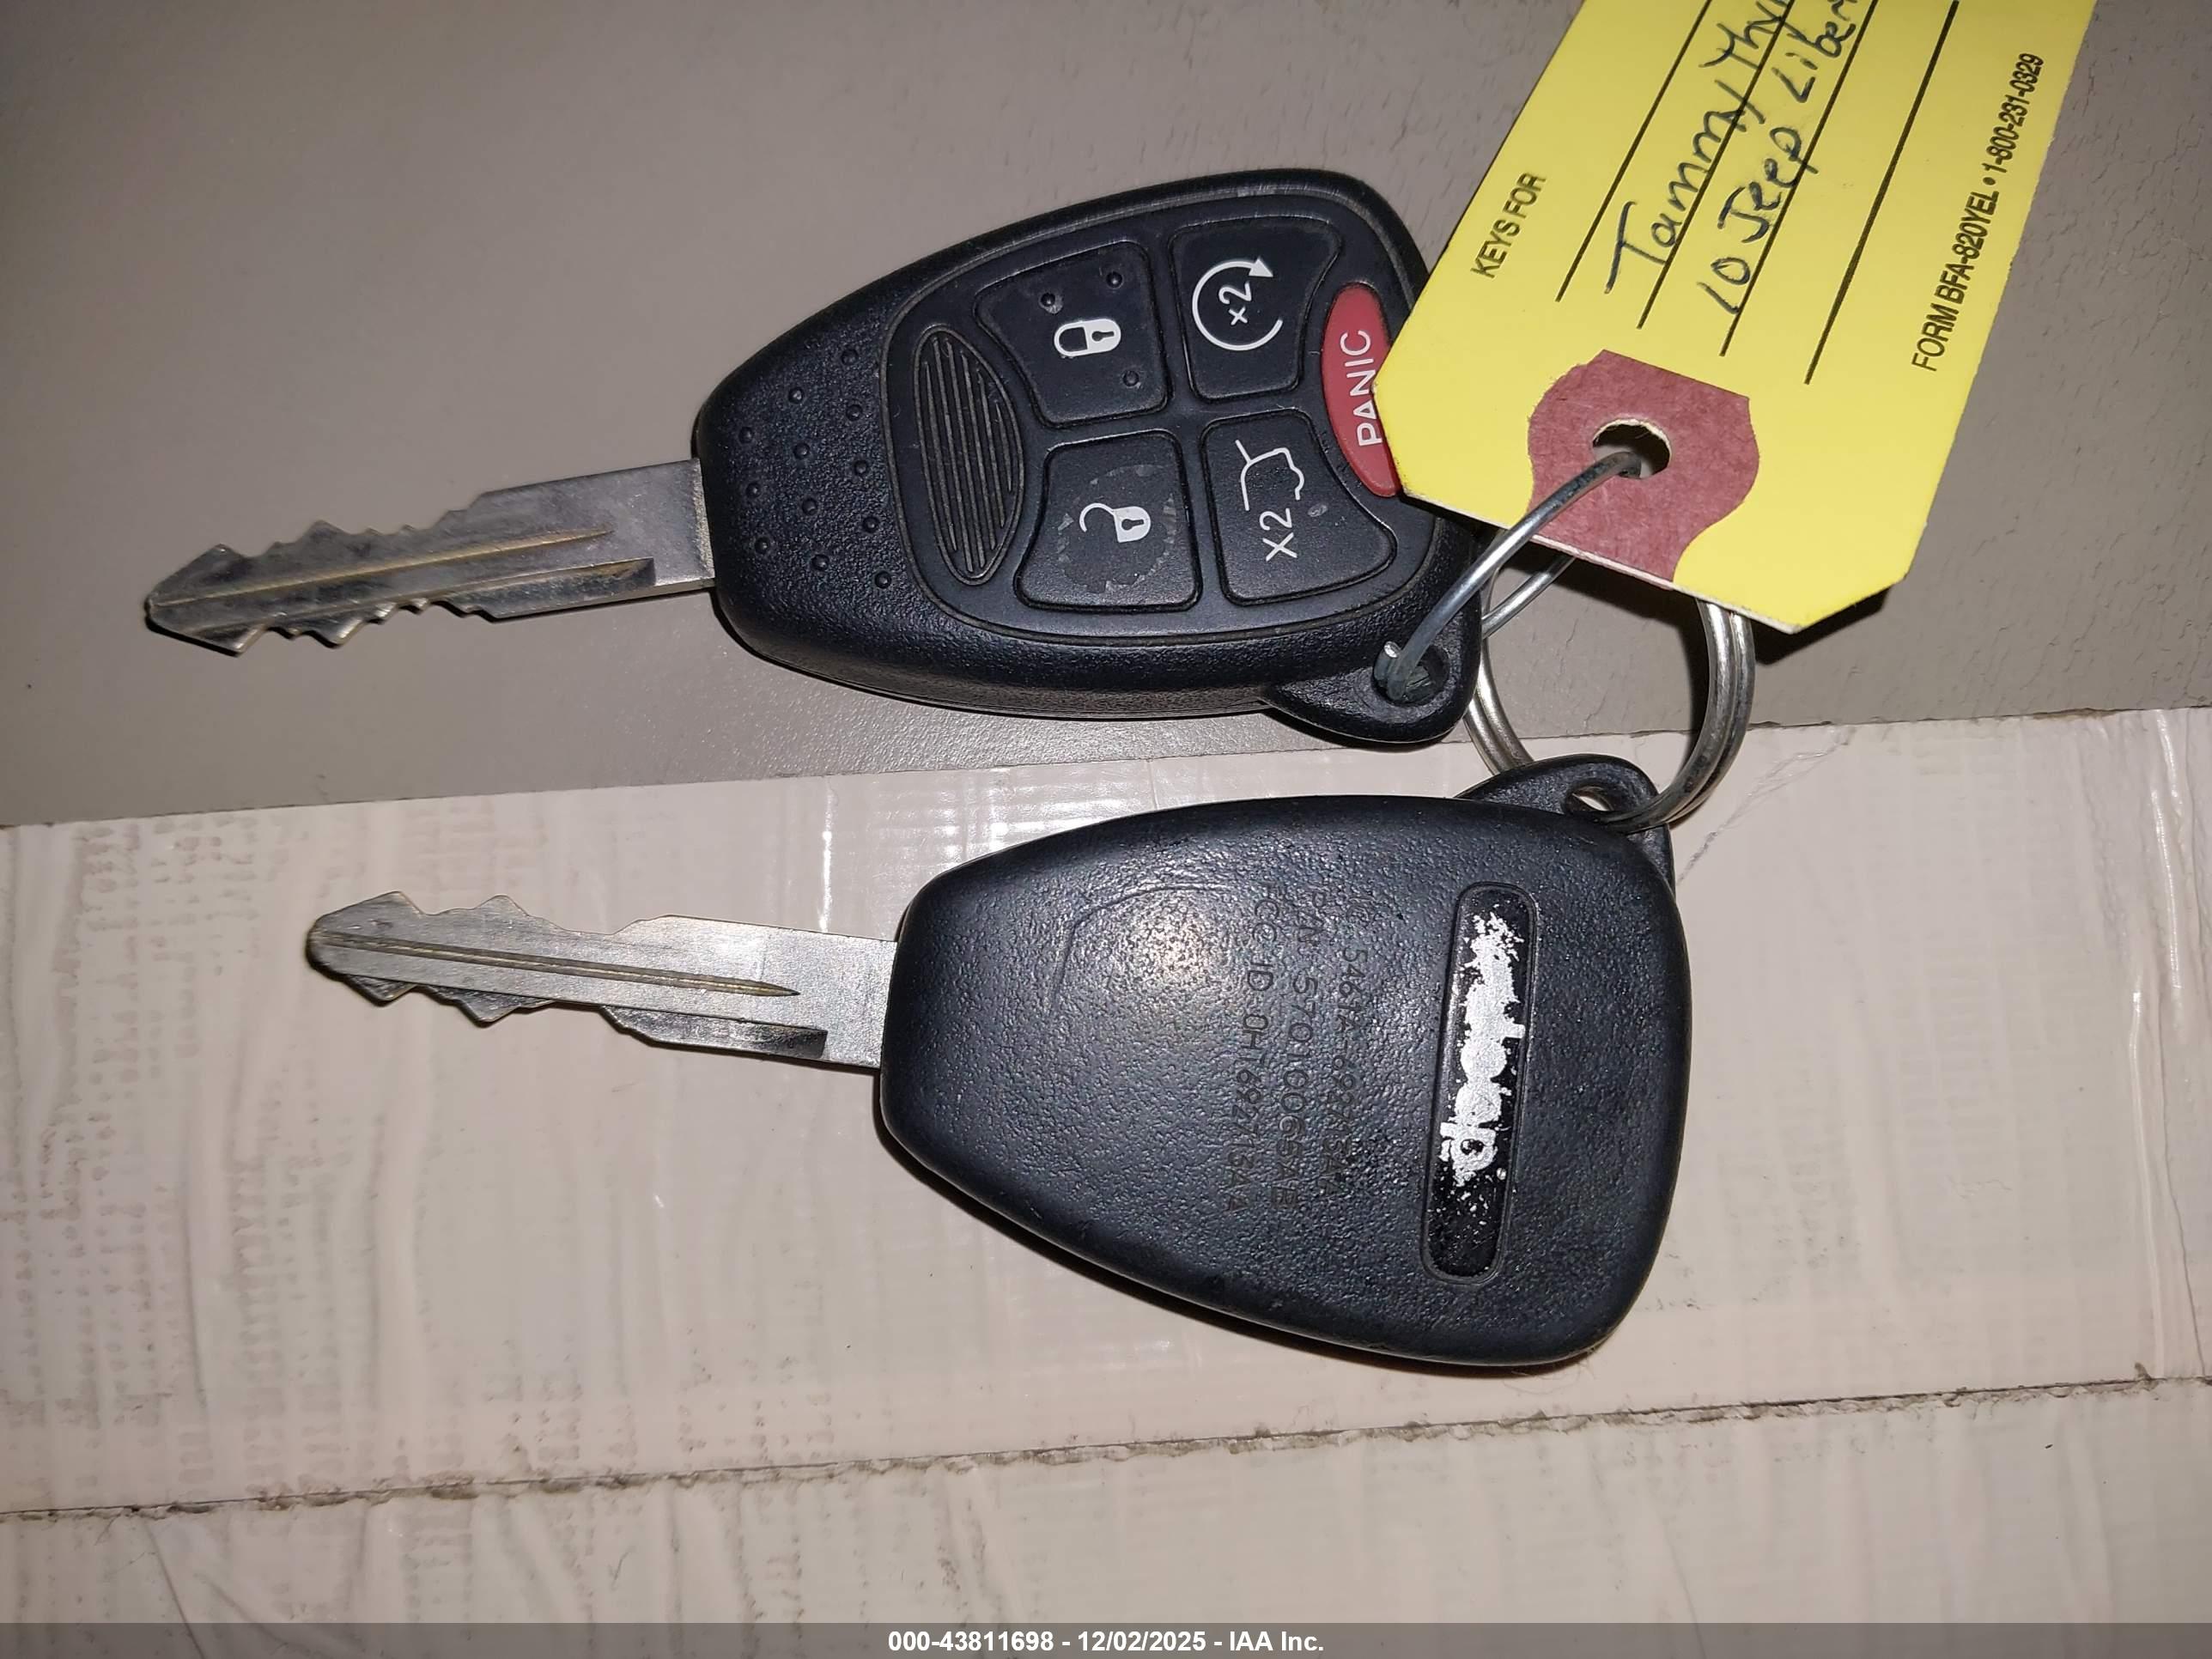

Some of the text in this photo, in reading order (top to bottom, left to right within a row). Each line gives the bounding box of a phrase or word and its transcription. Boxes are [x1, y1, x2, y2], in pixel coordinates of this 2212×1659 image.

[1981, 52, 2044, 173] 1-800-231-0329
[1469, 173, 1547, 278] KEYS FOR
[1717, 126, 1820, 244] Jeep
[1696, 257, 1751, 315] 10
[1934, 191, 2000, 305] BFA-820YEL
[1340, 330, 1381, 447] PANIC
[1911, 302, 1960, 371] FORM
